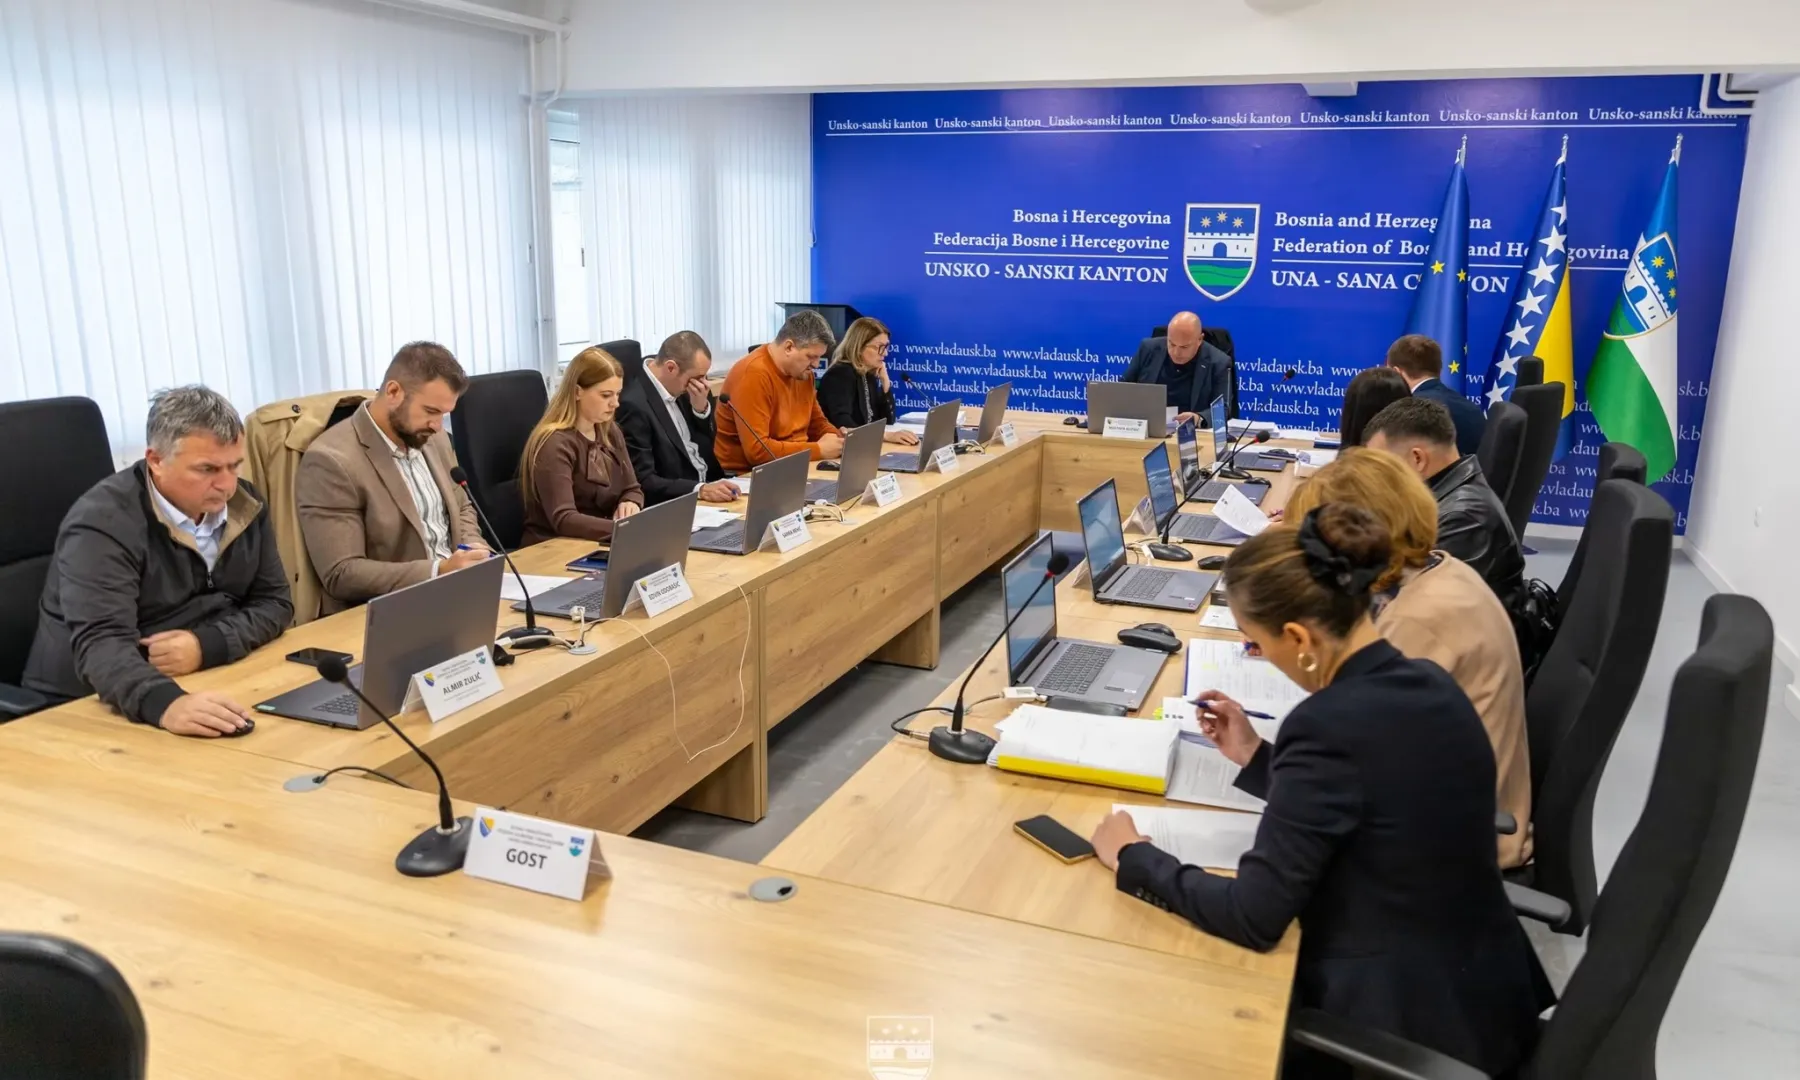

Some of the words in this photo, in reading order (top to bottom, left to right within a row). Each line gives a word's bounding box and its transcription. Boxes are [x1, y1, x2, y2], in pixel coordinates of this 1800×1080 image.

[828, 118, 891, 130] Unsko-sanski
[893, 118, 928, 129] kanton
[934, 117, 1003, 128] Unsko-sanski
[1004, 116, 1041, 127] kanton
[1048, 115, 1121, 127] Unsko-sanski
[1123, 114, 1162, 126] kanton
[1170, 113, 1247, 125] Unsko-sanski
[1250, 112, 1291, 124] kanton
[1300, 111, 1382, 123] Unsko-sanski
[1385, 110, 1430, 122] kanton
[1439, 108, 1528, 122] Unsko-sanski
[1530, 108, 1578, 120] kanton
[1588, 107, 1683, 120] Unsko-sanski
[1012, 209, 1059, 223] Bosna
[1062, 209, 1068, 223] i
[1071, 209, 1171, 228] Hercegovina
[1274, 211, 1333, 227] Bosnia
[1337, 212, 1371, 228] and
[1374, 213, 1492, 233] Herzegna
[933, 232, 1008, 250] Federacija
[1012, 233, 1058, 248] Bosne
[1061, 234, 1067, 248] i
[1071, 234, 1170, 252] Hercegovine
[1272, 238, 1368, 254] Federation
[1372, 239, 1393, 254] of
[1468, 241, 1501, 257] and
[1505, 242, 1630, 263] Hgovina
[924, 261, 990, 278] UNSKO
[1004, 263, 1074, 280] SANSKI
[1078, 266, 1168, 283] KANTON
[1271, 270, 1320, 287] UNA
[1336, 272, 1398, 290] SANA
[1403, 273, 1510, 292] CON
[905, 342, 996, 357] www.vladausk.ba
[1003, 347, 1099, 363] www.vladausk.ba
[1235, 357, 1324, 375] w.vladausk.ba
[885, 358, 948, 373] .vladausk.ba
[953, 362, 1047, 379] www.vladausk.ba
[1271, 381, 1347, 397] www.vladau
[443, 680, 463, 695] ALMIR
[506, 848, 548, 869] GOST
